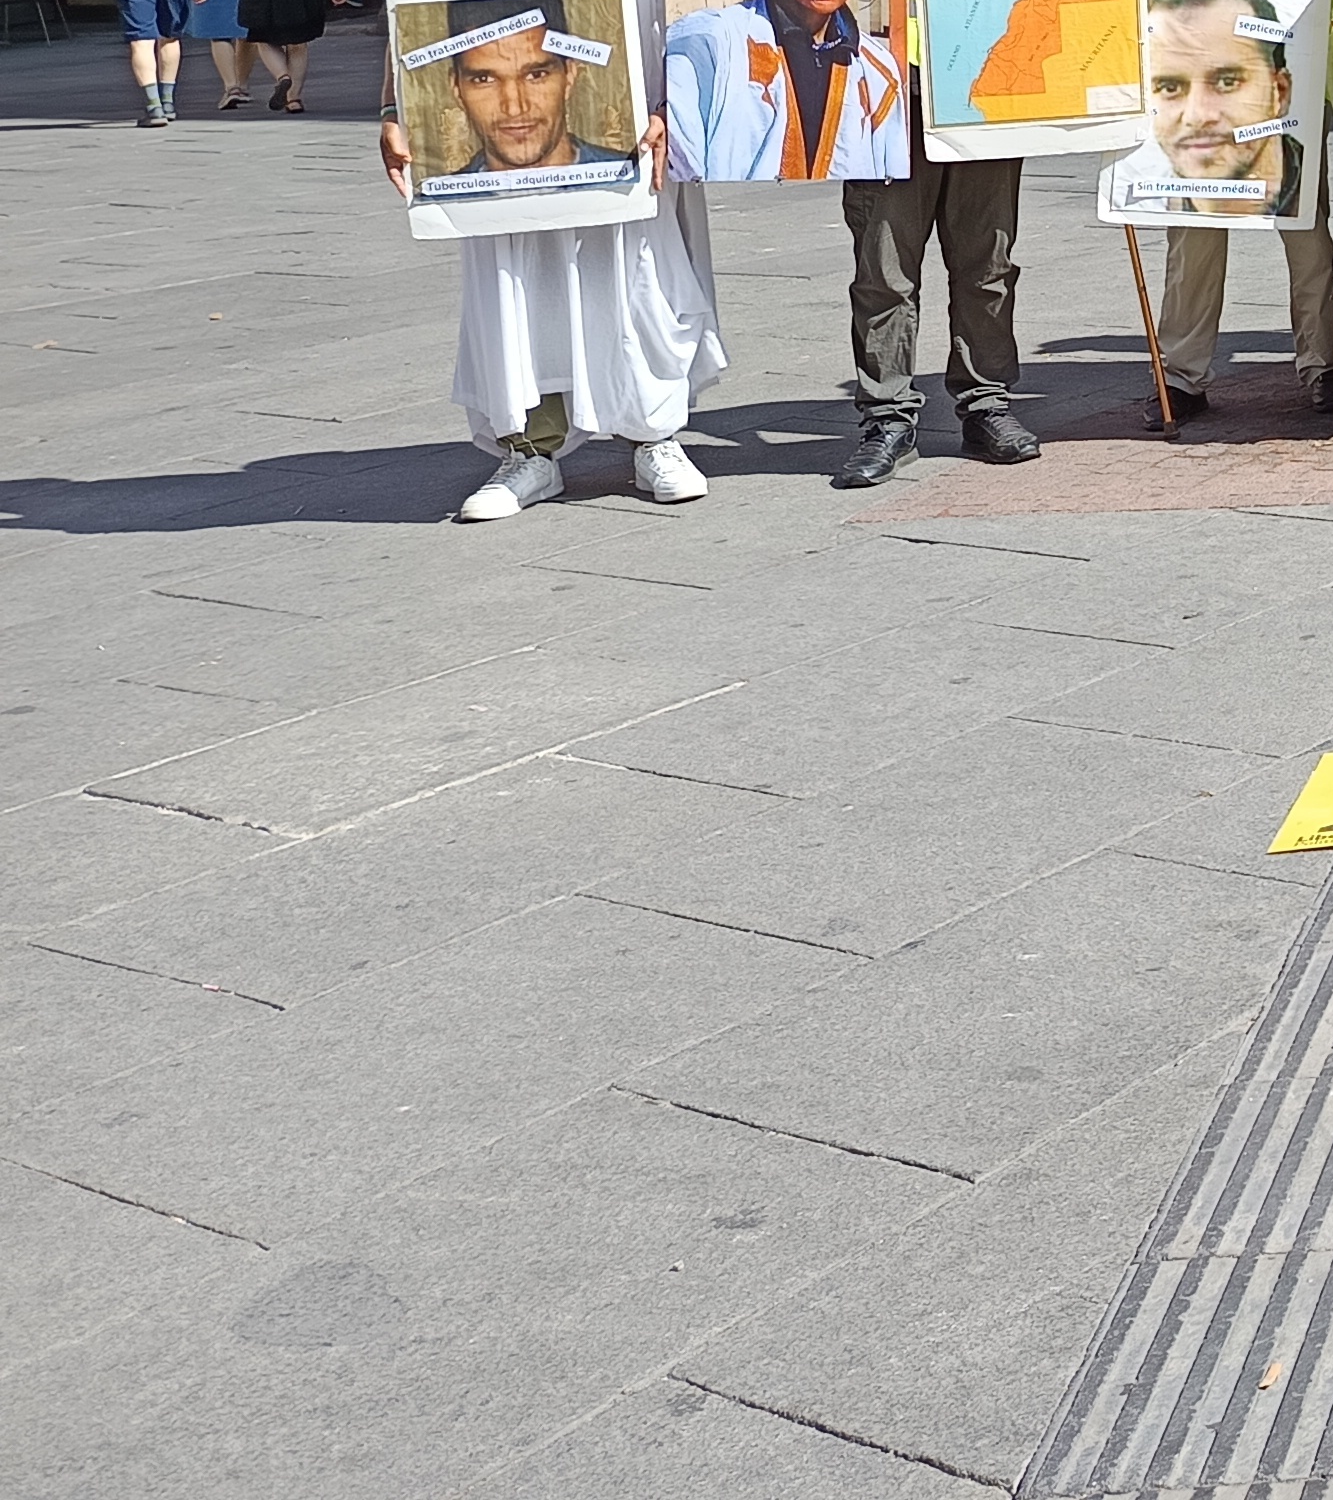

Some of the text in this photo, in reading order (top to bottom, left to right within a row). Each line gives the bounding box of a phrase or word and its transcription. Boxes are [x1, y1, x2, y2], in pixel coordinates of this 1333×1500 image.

[407, 13, 540, 67] Sin tratamiento médico
[1239, 19, 1294, 40] septicemia
[549, 37, 602, 59] Se asfixia
[1238, 119, 1299, 140] Aislamiento
[427, 167, 629, 192] Tuberculosis adquirida en la cárcel
[1137, 181, 1260, 194] Sin tratamiento médico
